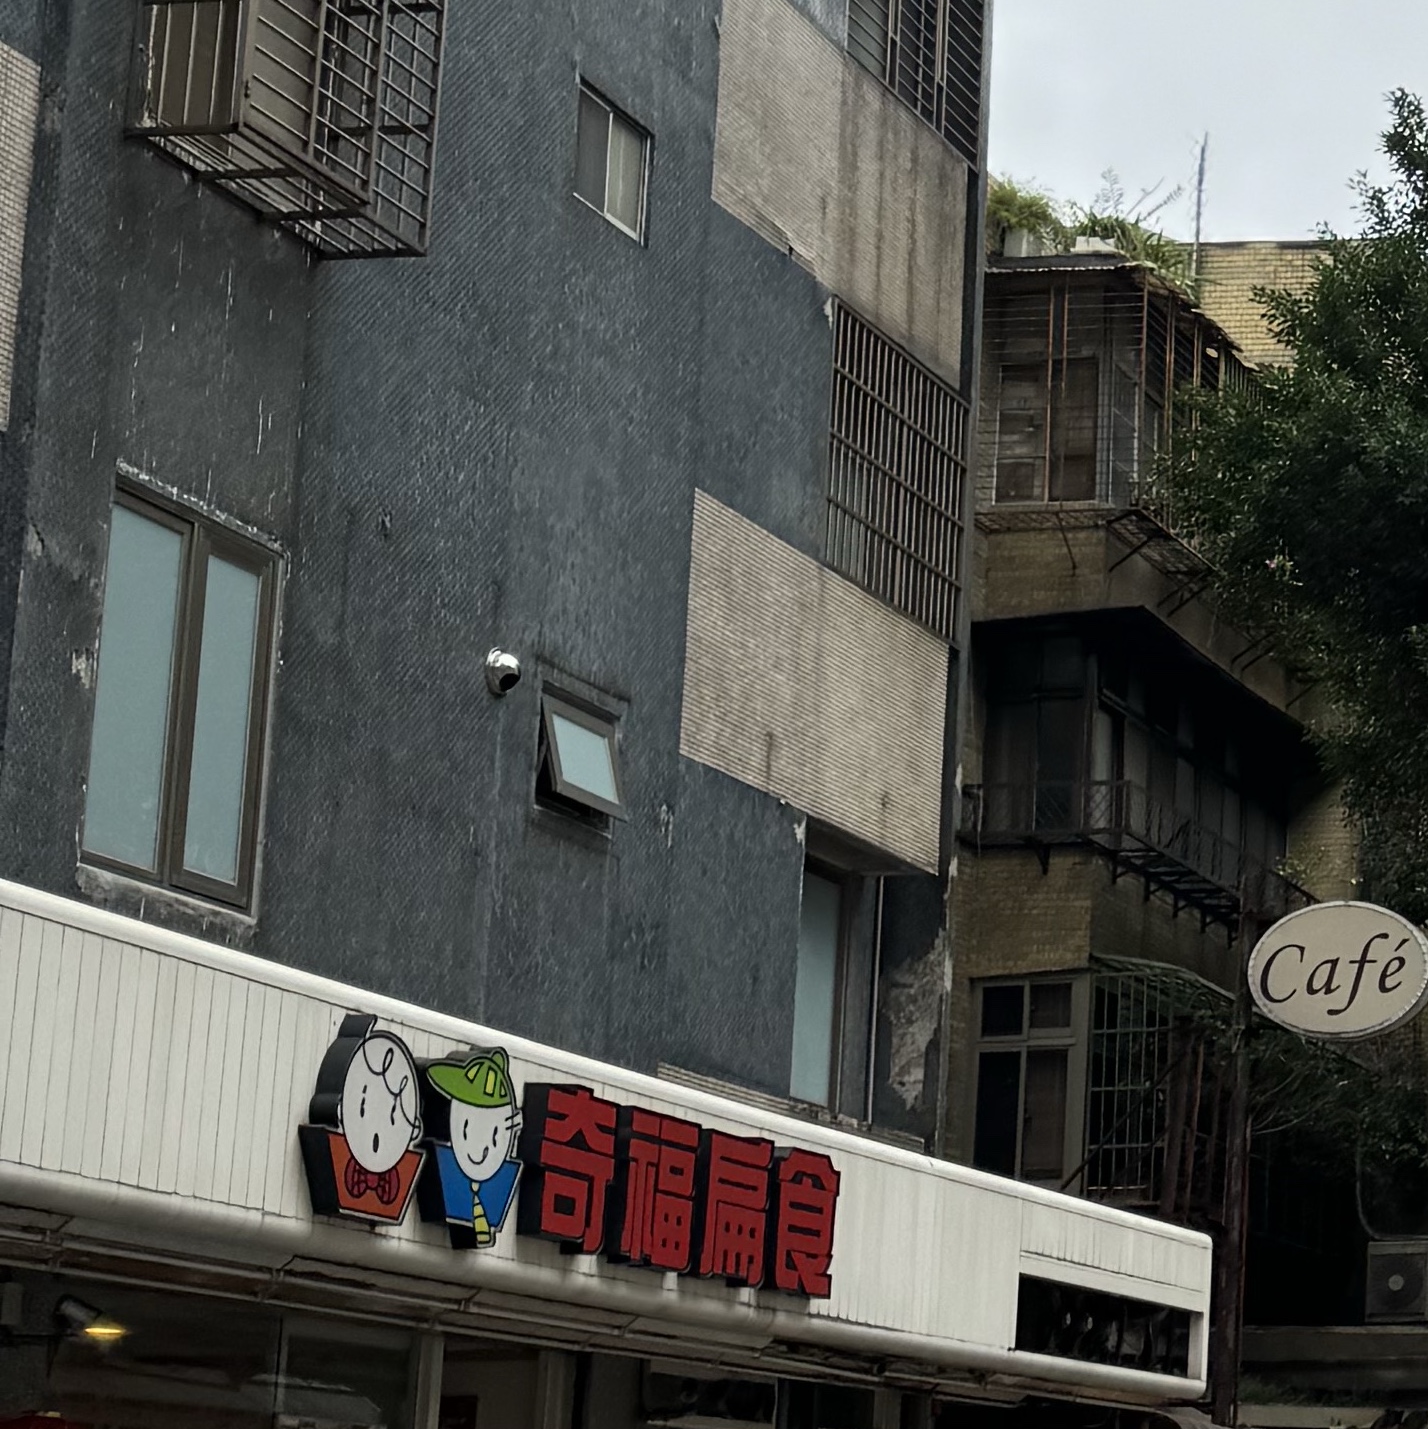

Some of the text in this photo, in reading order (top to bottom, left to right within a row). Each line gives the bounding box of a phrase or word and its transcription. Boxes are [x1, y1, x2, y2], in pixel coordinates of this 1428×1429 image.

[1259, 933, 1408, 1018] Café
[541, 1084, 841, 1299] 奇福扁食
